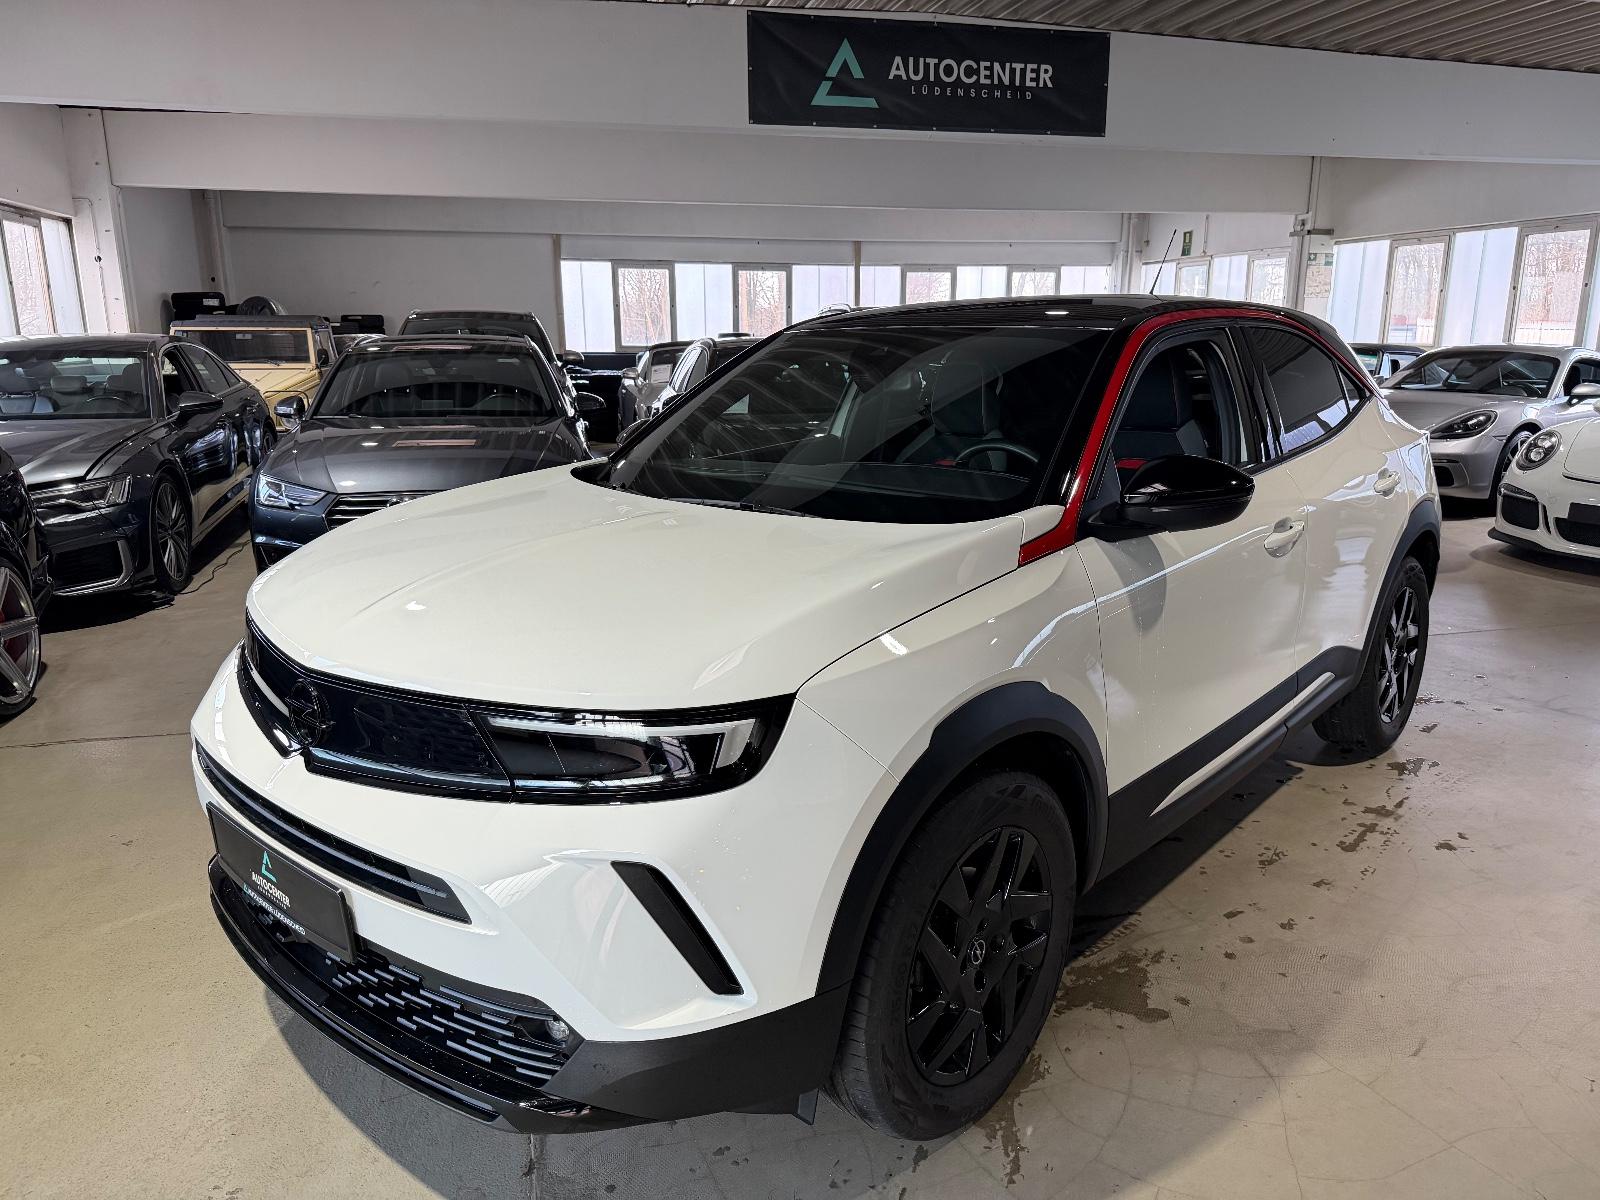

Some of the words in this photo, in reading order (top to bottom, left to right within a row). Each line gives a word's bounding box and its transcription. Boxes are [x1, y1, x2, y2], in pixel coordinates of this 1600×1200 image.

[888, 55, 1053, 88] AUTOCENTER
[911, 84, 1032, 100] LÜDENSCHEID
[251, 871, 290, 907] AUTOCENTER
